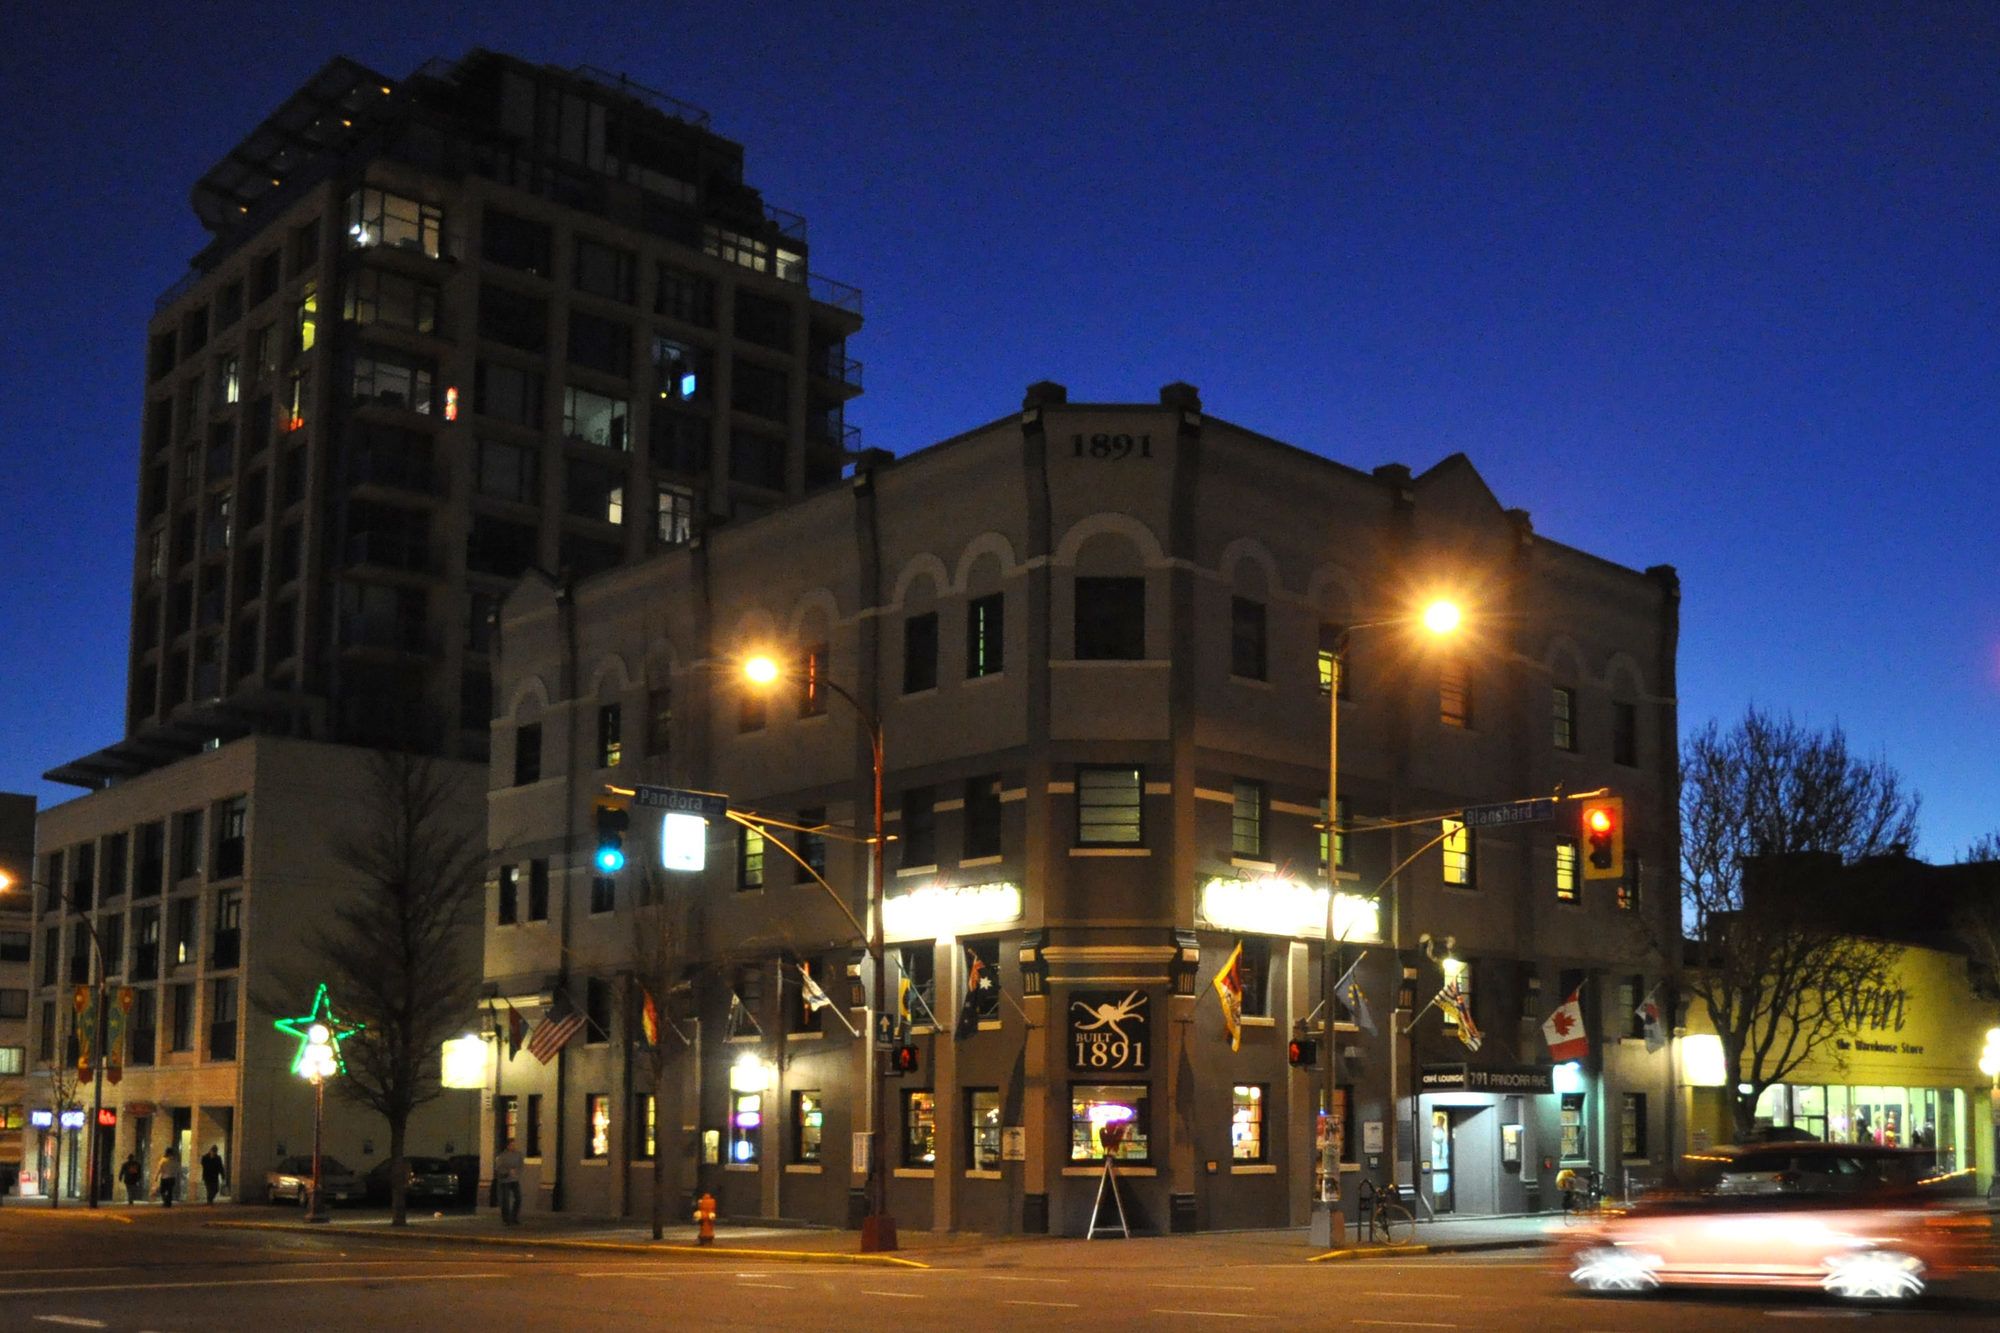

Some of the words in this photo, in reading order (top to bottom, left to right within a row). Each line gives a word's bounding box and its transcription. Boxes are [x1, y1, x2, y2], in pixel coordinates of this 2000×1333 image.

[1071, 432, 1154, 460] 1891
[640, 787, 703, 810] Pandora
[1466, 801, 1533, 825] Blanshard
[1076, 1032, 1112, 1042] BUILT
[1855, 1039, 1898, 1054] Warehouse
[1901, 1042, 1924, 1054] Store
[1076, 1041, 1145, 1070] 1891
[1470, 1072, 1488, 1086] 791
[1490, 1073, 1530, 1087] PANDORA
